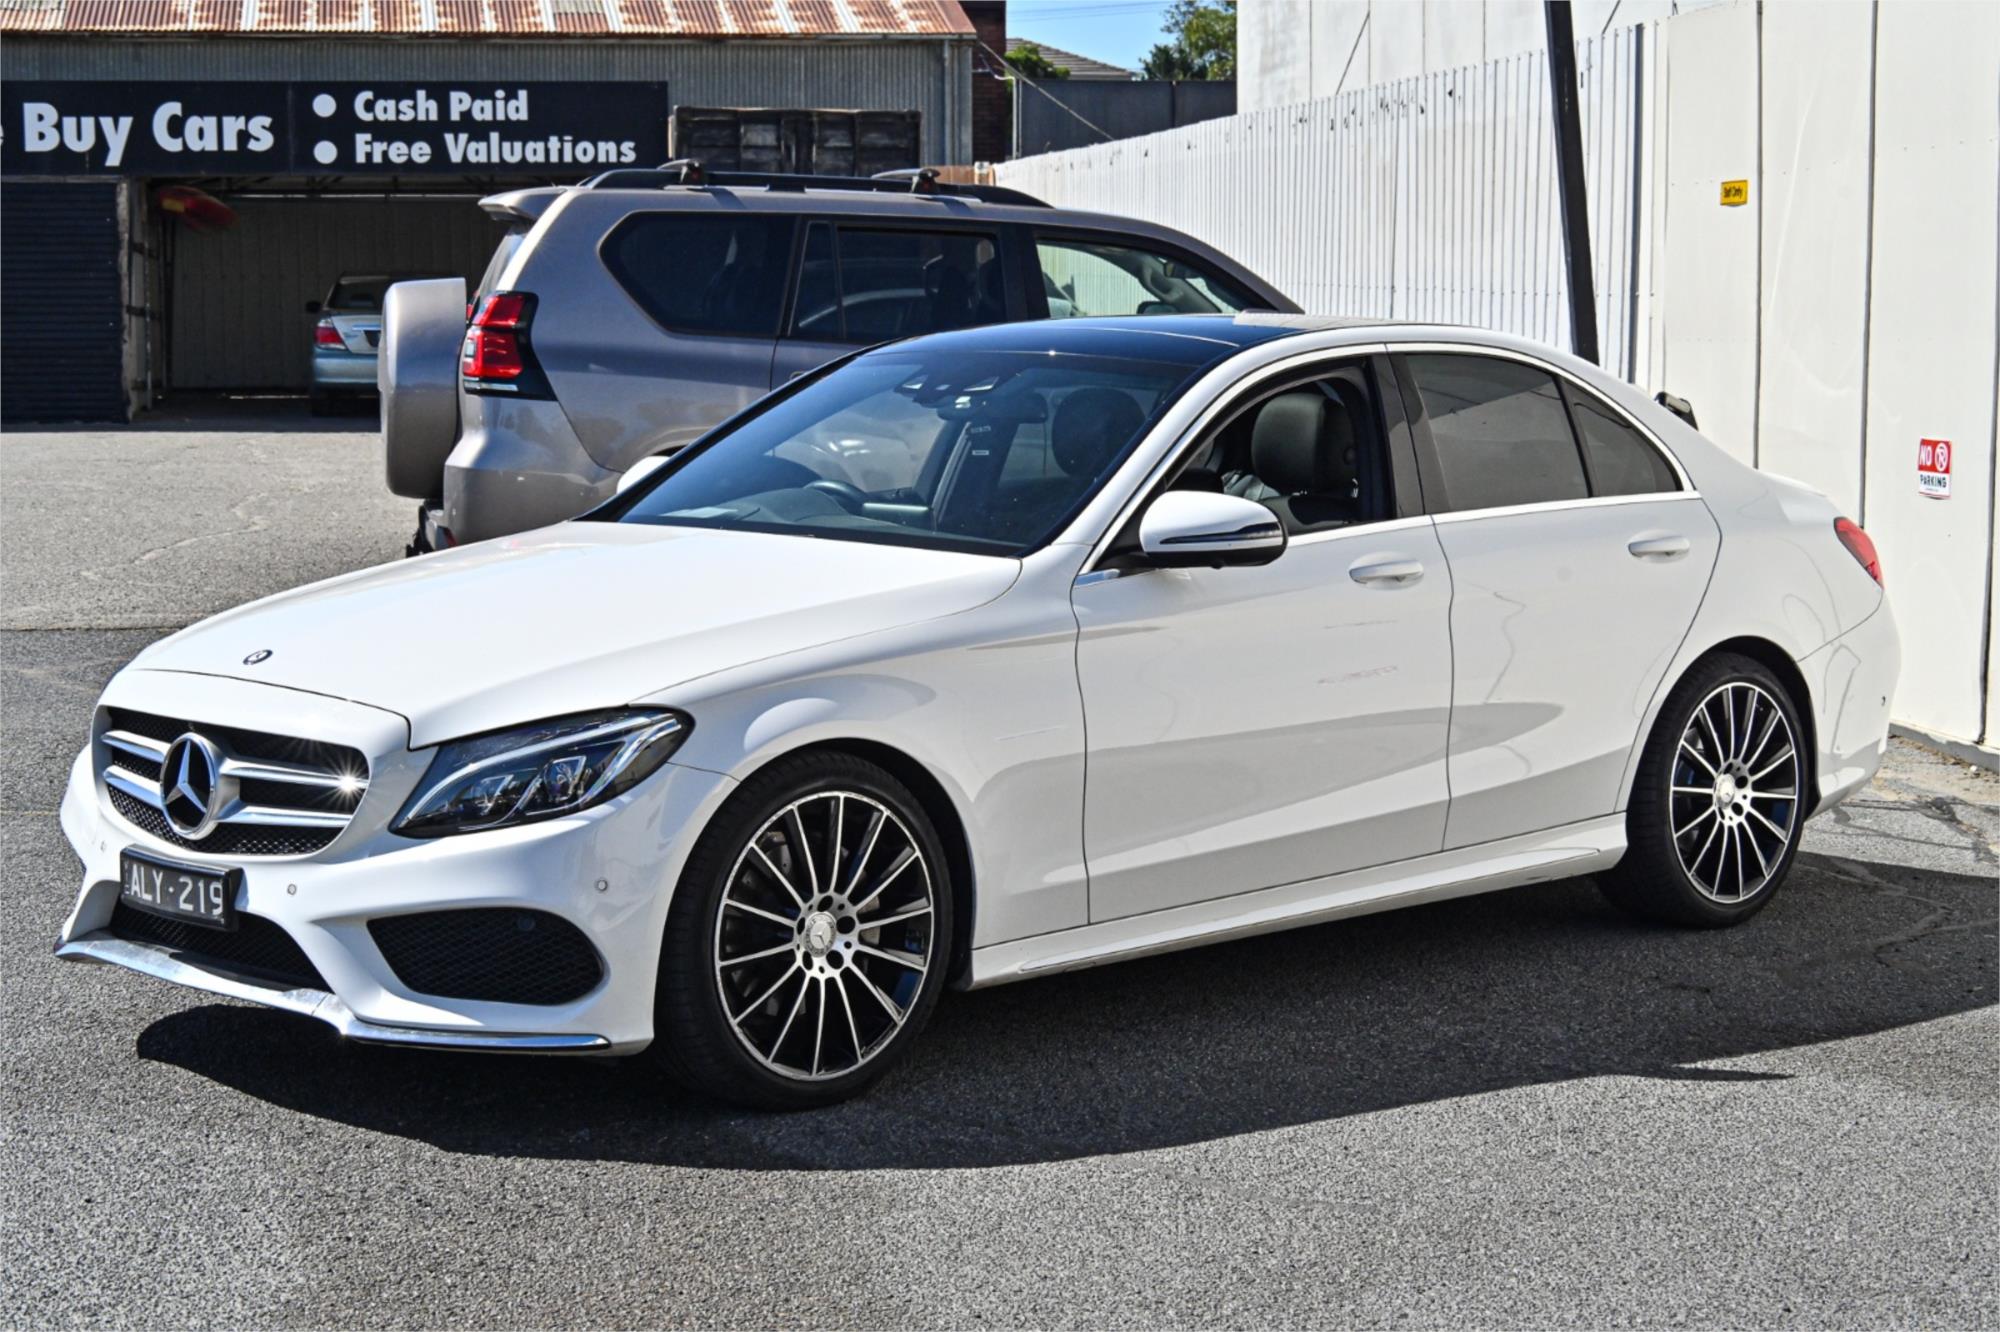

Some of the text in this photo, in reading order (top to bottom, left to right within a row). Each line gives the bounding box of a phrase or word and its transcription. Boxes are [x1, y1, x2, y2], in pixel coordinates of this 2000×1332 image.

[354, 90, 529, 122] Cash Paid
[23, 102, 133, 167] Buy
[152, 101, 274, 152] Cars
[355, 131, 637, 163] Free Valuations
[1920, 445, 1932, 466] NO
[1920, 474, 1947, 488] PARKING
